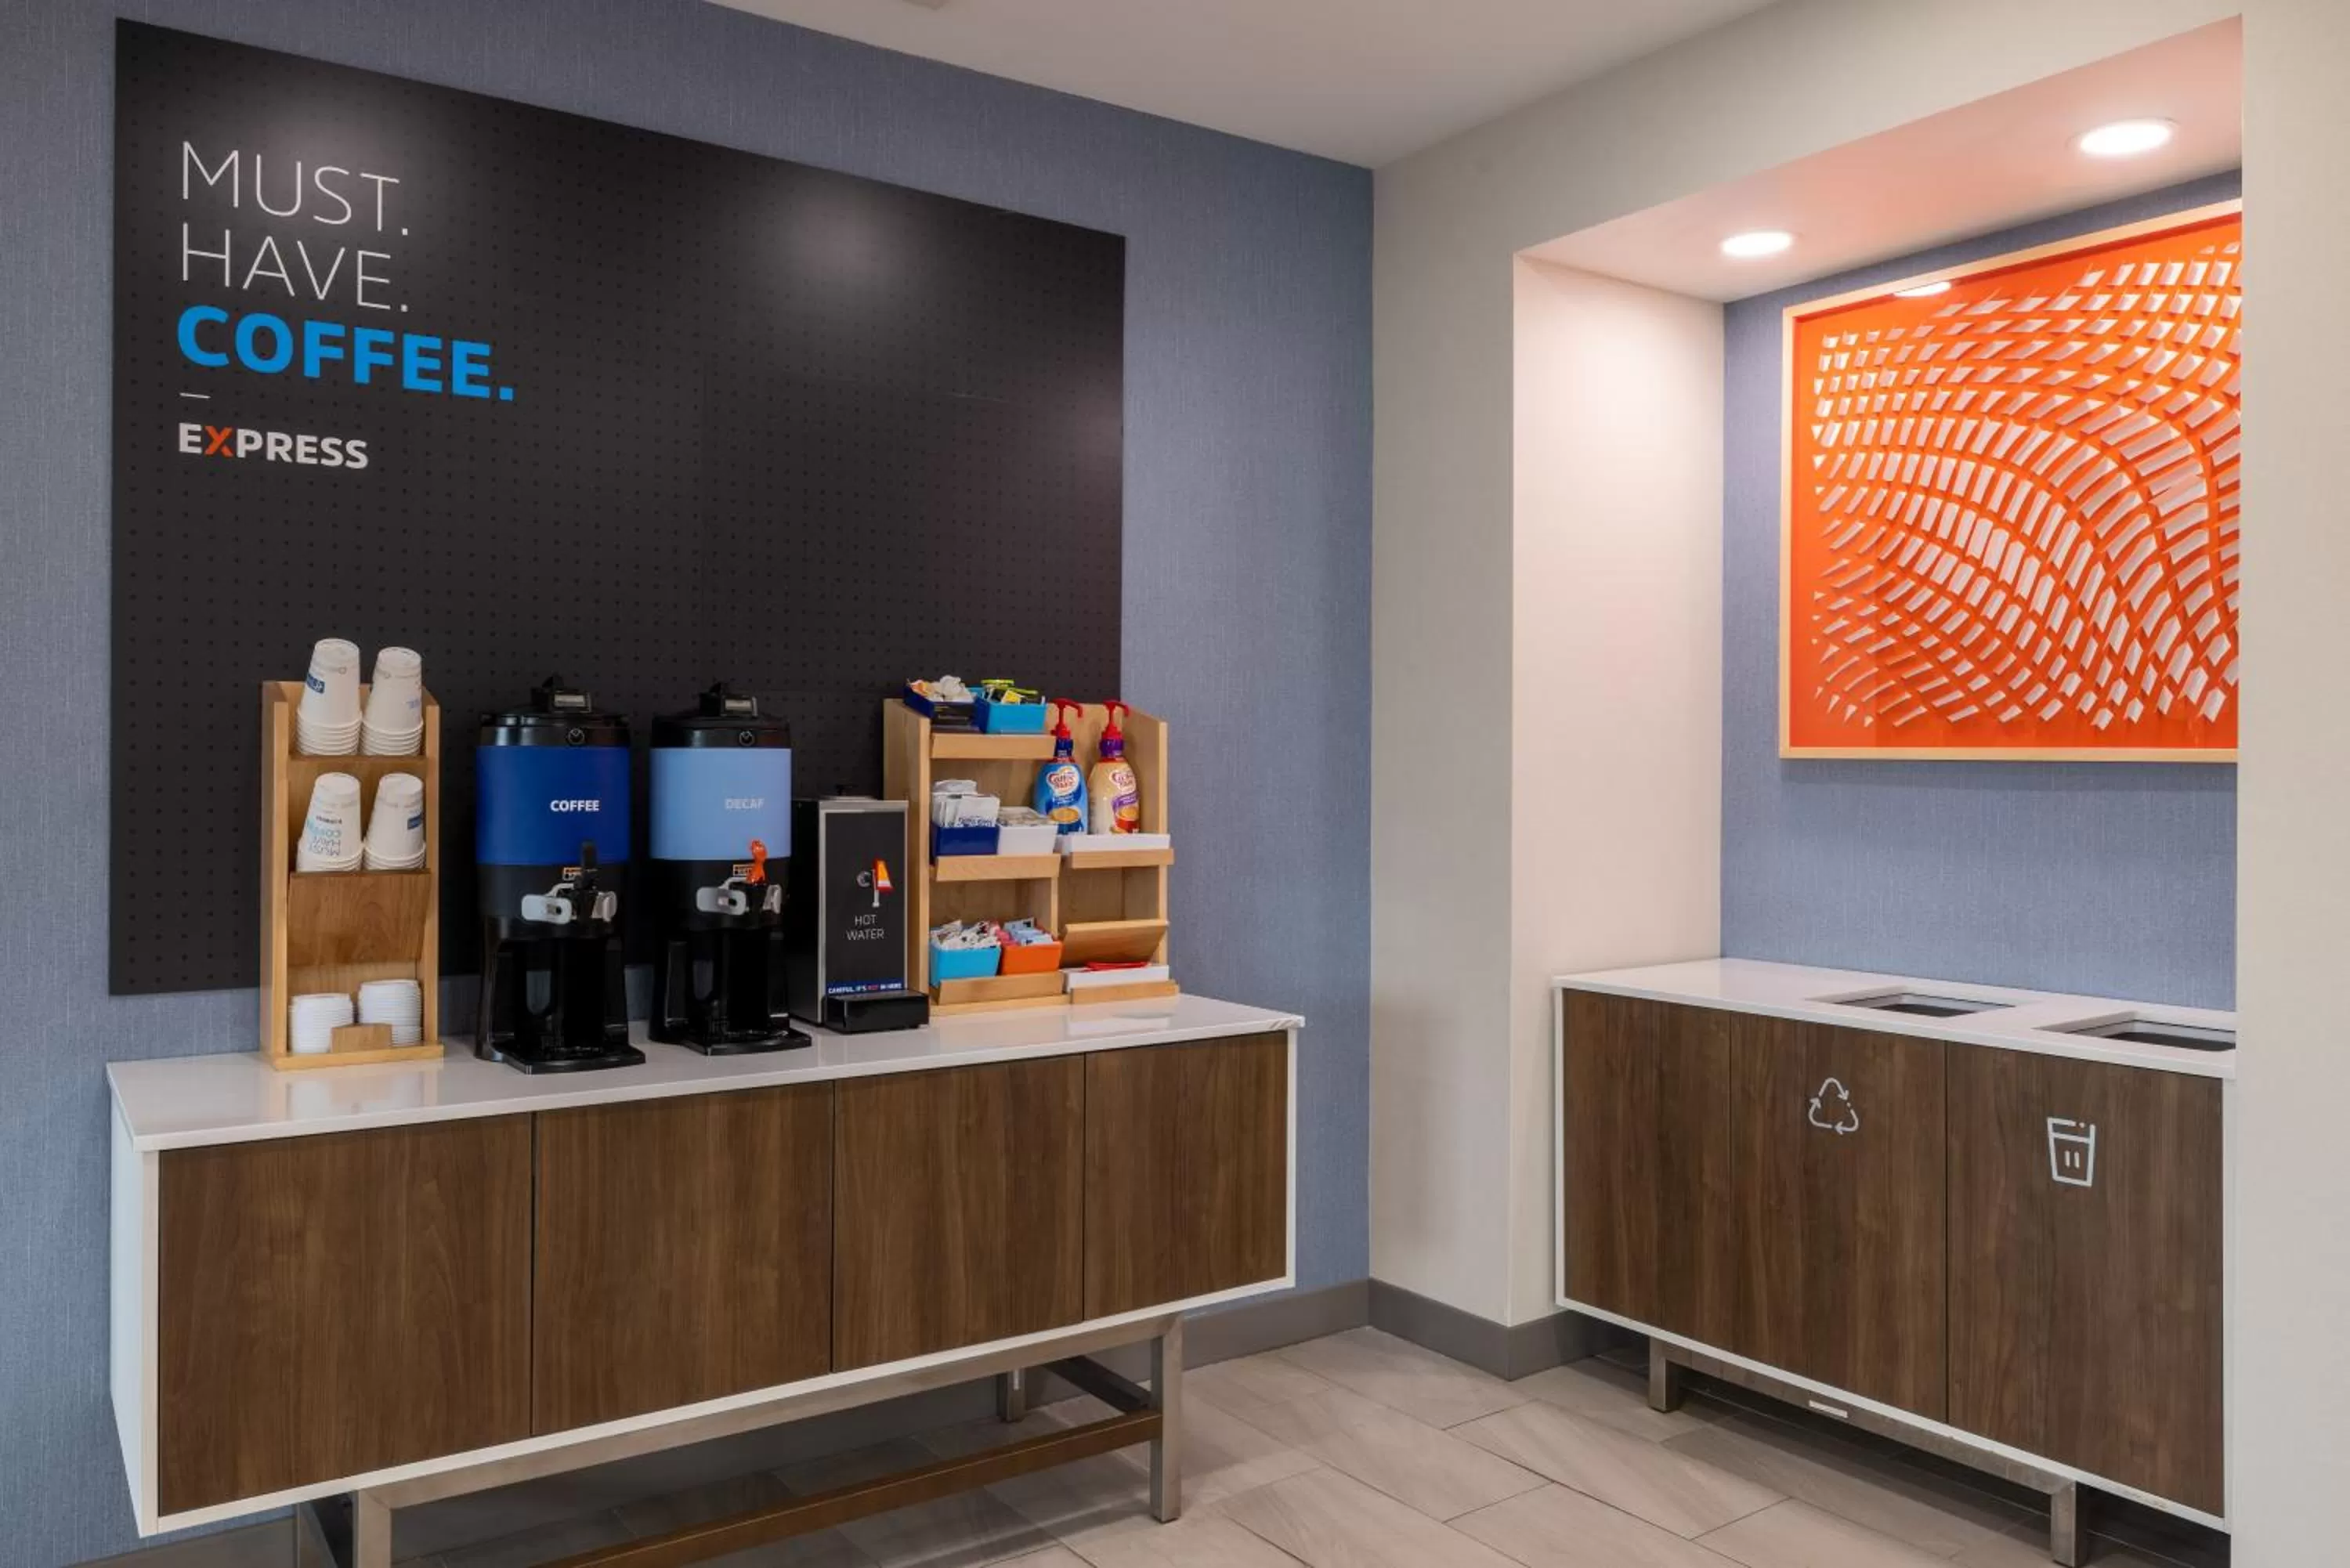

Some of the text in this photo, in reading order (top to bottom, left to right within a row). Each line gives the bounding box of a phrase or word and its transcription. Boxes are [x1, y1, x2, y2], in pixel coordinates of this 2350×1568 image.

[183, 140, 408, 235] MUST.
[183, 222, 408, 312] HAVE.
[177, 305, 514, 401] COFFEE.
[179, 422, 369, 468] EXPRESS
[550, 800, 599, 812] COFFEE
[725, 798, 765, 809] DECAF
[846, 928, 884, 940] WATER
[855, 914, 877, 926] HOT
